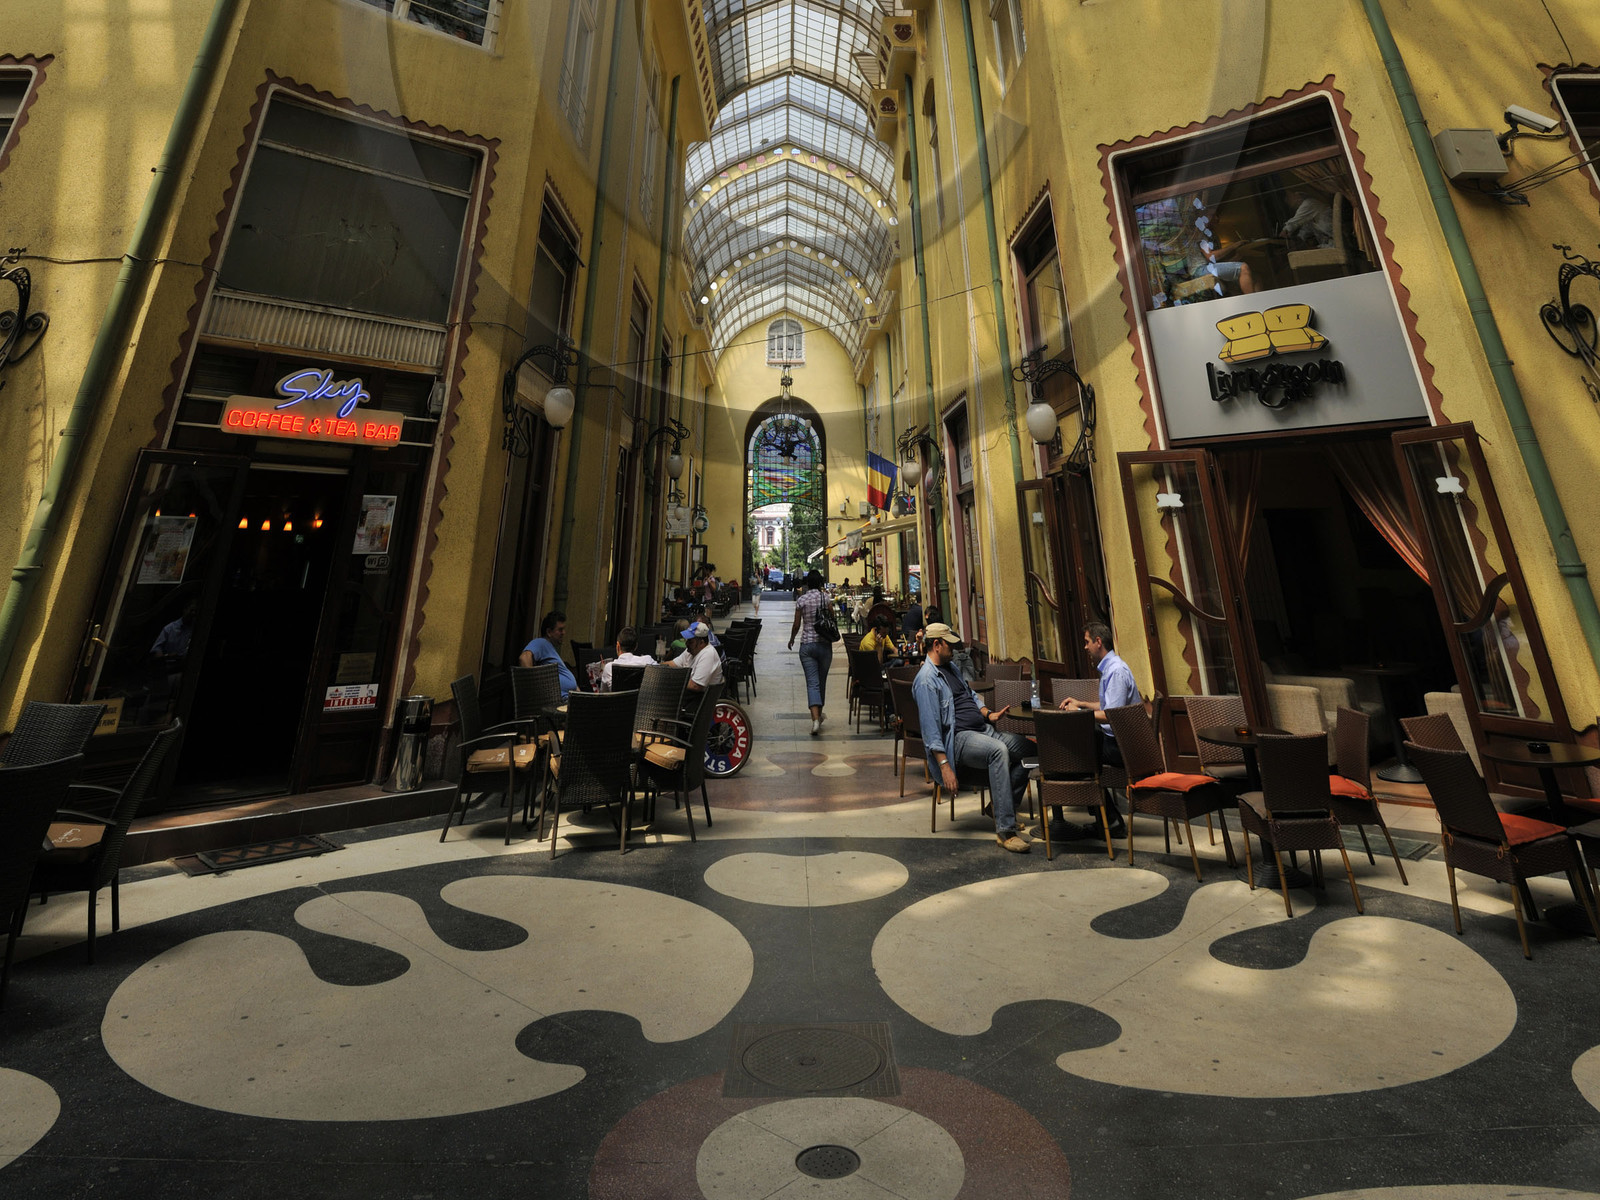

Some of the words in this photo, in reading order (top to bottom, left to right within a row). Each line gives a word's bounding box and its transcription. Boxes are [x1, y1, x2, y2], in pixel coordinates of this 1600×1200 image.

[276, 371, 369, 419] Sky
[227, 409, 305, 433] COFFEE
[309, 418, 322, 434] &
[324, 419, 358, 437] TEA
[363, 422, 401, 441] BAR
[356, 697, 371, 705] SEC
[716, 707, 747, 759] STEAUA
